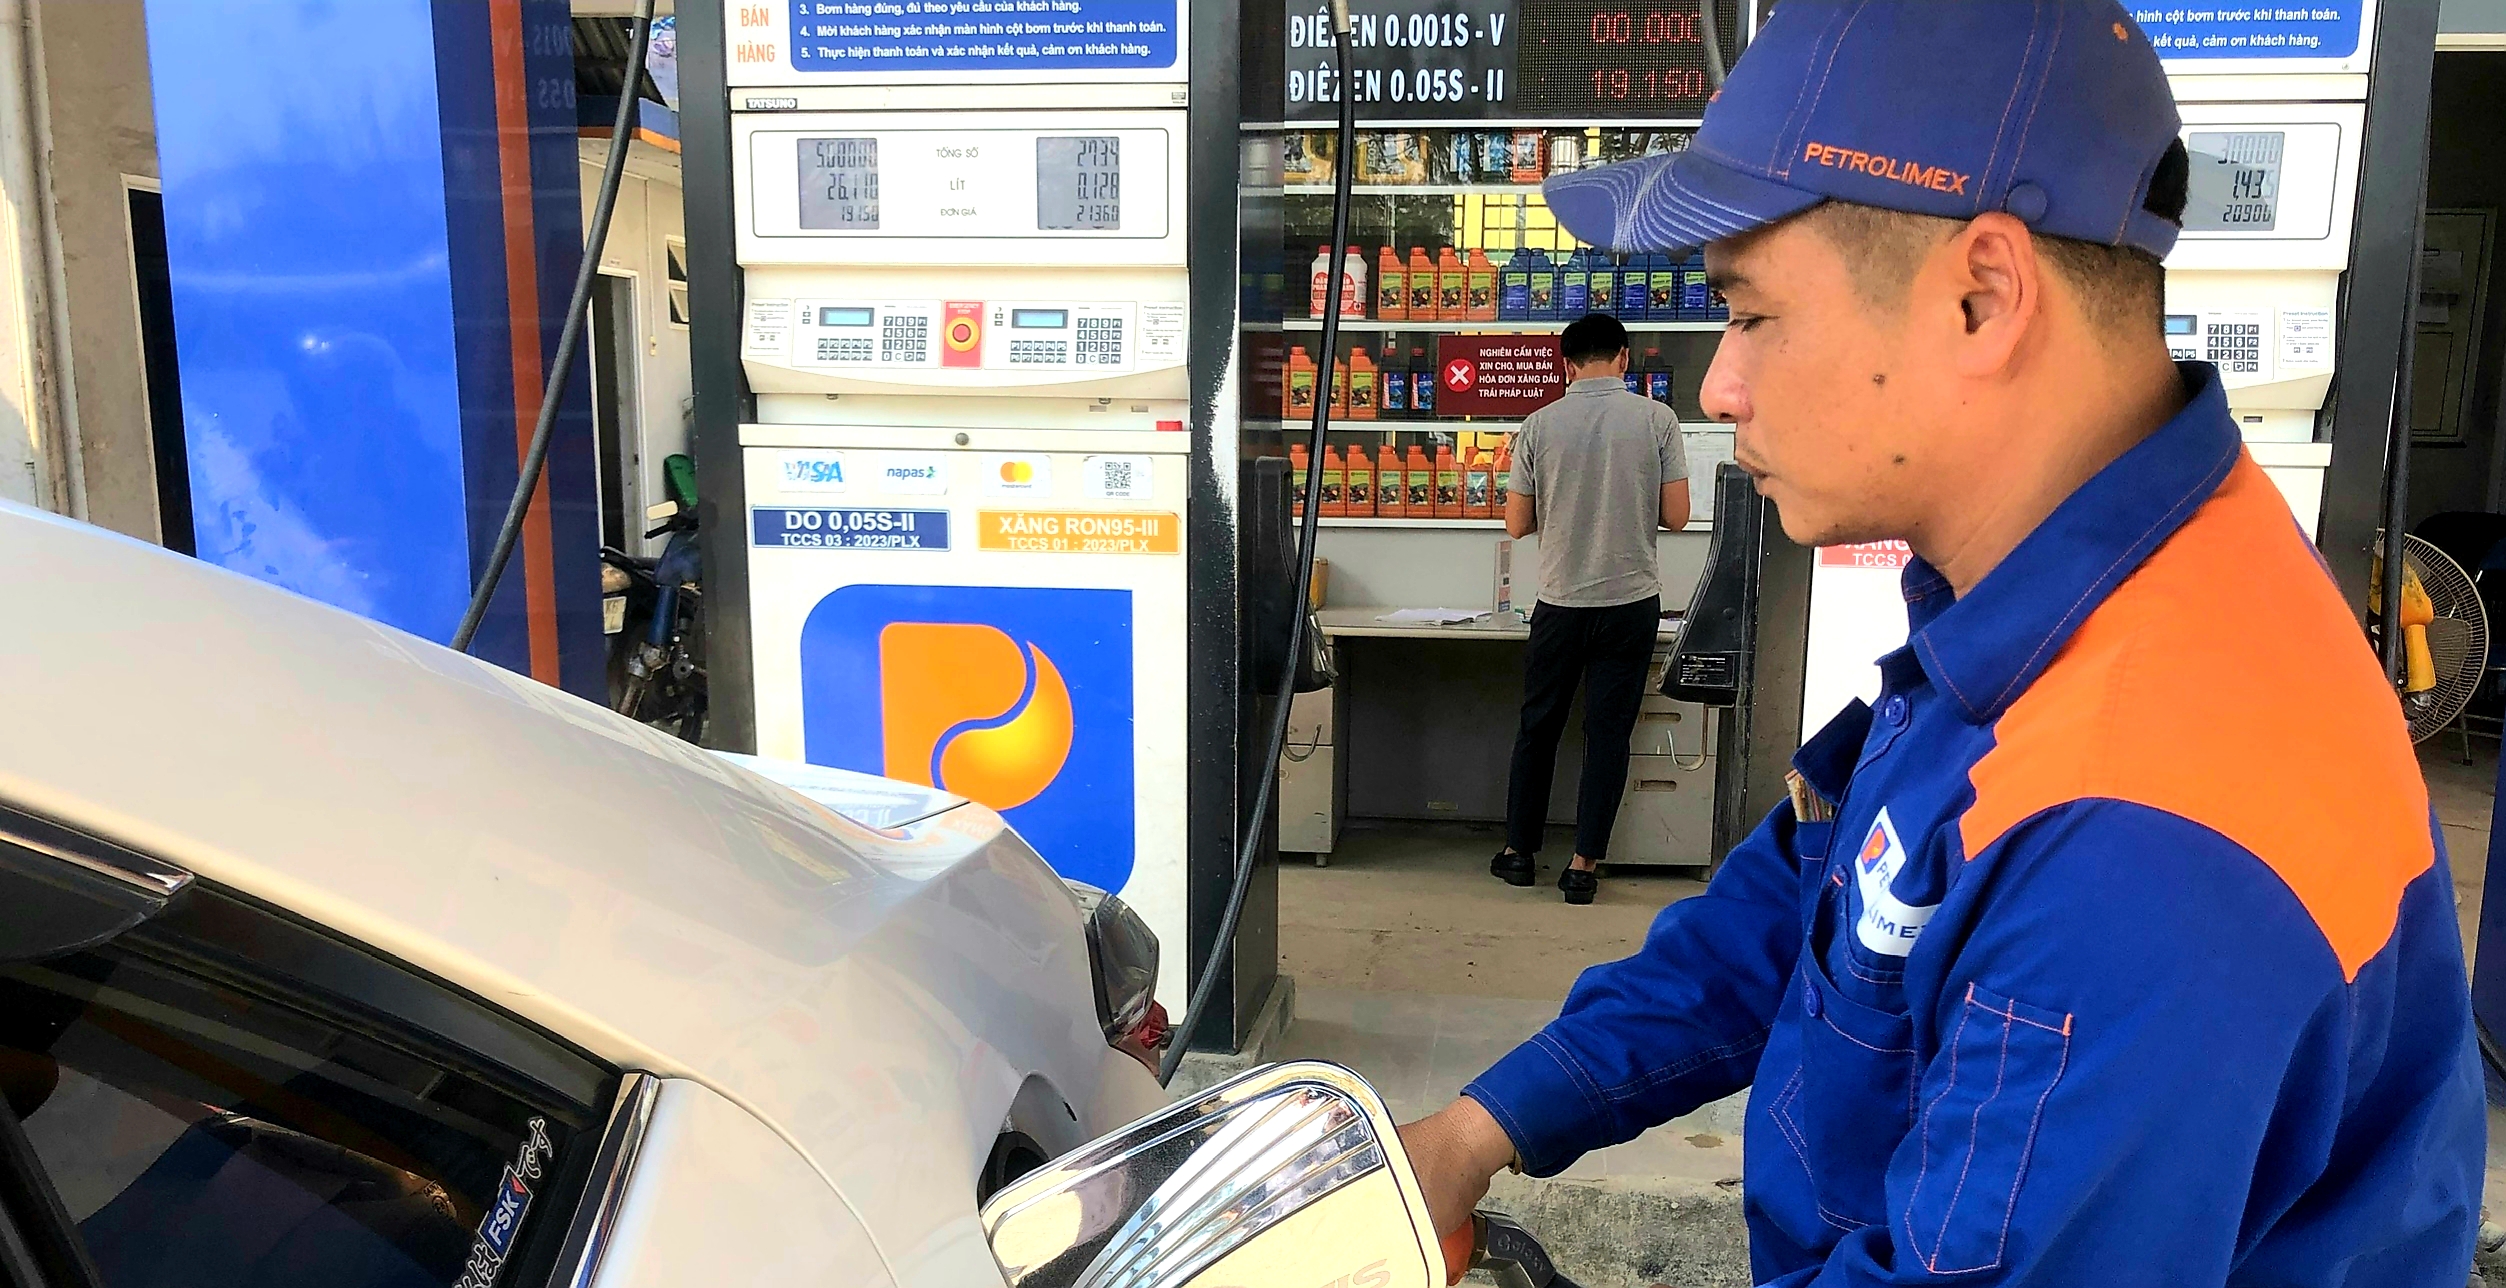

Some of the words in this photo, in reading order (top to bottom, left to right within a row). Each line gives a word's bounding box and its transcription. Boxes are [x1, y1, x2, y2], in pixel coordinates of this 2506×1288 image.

[741, 4, 769, 27] BÁN
[800, 4, 809, 15] 3.
[817, 4, 842, 14] Bơm
[845, 3, 872, 16] hàng
[874, 2, 904, 16] đúng,
[907, 2, 920, 13] đủ
[925, 2, 948, 12] theo
[950, 2, 969, 15] yêu
[995, 2, 1014, 12] của
[1017, 0, 1049, 12] khách
[1052, 0, 1082, 13] hàng.
[2136, 9, 2162, 22] hình
[2166, 9, 2185, 24] cột
[2187, 9, 2214, 22] bơm
[2217, 9, 2250, 21] trước
[2254, 8, 2272, 21] khi
[2275, 8, 2311, 21] thanh
[2312, 7, 2340, 21] toán.
[800, 26, 810, 36] 4.
[817, 25, 837, 36] Mời
[840, 25, 872, 36] khách
[875, 25, 901, 38] hàng
[903, 24, 922, 35] xác
[925, 23, 952, 37] nhận
[954, 24, 977, 35] màn
[980, 23, 1003, 34] hình
[1006, 22, 1023, 36] cột
[1026, 22, 1051, 34] bơm
[1053, 21, 1084, 34] trước
[1087, 22, 1103, 33] khi
[1106, 22, 1136, 33] thanh
[1139, 20, 1166, 33] toán.
[1290, 6, 1377, 47] ĐIÊEN
[1385, 13, 1469, 47] 0.001S
[1490, 14, 1505, 45] V
[2153, 33, 2171, 47] kết
[2174, 34, 2199, 49] quả,
[2203, 34, 2226, 47] cảm
[2230, 35, 2247, 46] ơn
[2250, 34, 2285, 46] khách
[2289, 34, 2321, 48] hàng.
[737, 40, 775, 62] HÀNG
[801, 47, 811, 58] 5.
[817, 47, 845, 60] Thực
[848, 46, 870, 59] hiện
[873, 46, 903, 58] thanh
[906, 45, 929, 57] toán
[931, 46, 944, 57] và
[947, 45, 966, 57] xác
[968, 45, 995, 58] nhận
[998, 42, 1014, 56] kết
[1016, 43, 1039, 58] quả,
[1042, 43, 1065, 55] cảm
[1068, 43, 1083, 55] ơn
[1085, 43, 1118, 55] khách
[1121, 43, 1151, 57] hàng.
[1390, 69, 1463, 101] 0.05S
[1487, 69, 1503, 101] II
[747, 98, 796, 109] TATSUNO
[936, 147, 962, 158] TỔNG
[966, 147, 979, 158] SỐ
[1804, 142, 1970, 196] PETROLIMEX
[950, 178, 965, 190] LÍT
[940, 208, 959, 216] ĐƠN
[961, 206, 977, 216] GIÁ
[1077, 205, 1119, 222] 21360
[1480, 347, 1511, 357] NGHIÊM
[1514, 345, 1531, 356] CẤM
[1534, 347, 1552, 358] VIỆC
[1480, 362, 1493, 370] XIN
[1495, 362, 1514, 370] CHO,
[1516, 362, 1533, 370] MUA
[1536, 360, 1552, 370] BÁN
[1498, 375, 1515, 383] ĐƠN
[1518, 373, 1540, 383] XĂNG
[1479, 387, 1497, 397] TRÁI
[1499, 387, 1521, 397] PHÁP
[1523, 387, 1544, 399] LUẬT
[887, 468, 924, 480] napas
[785, 511, 822, 529] DO
[829, 512, 915, 533] 0,05S-II
[1000, 512, 1058, 534] XĂNG
[1066, 517, 1159, 536] RON95-III
[781, 533, 822, 546] TCCS
[825, 534, 842, 546] 03
[854, 534, 921, 548] 2023/PLX
[1008, 537, 1048, 550] TCCS
[1053, 538, 1068, 550] 01
[1083, 538, 1148, 552] 2023/PLX
[1852, 554, 1897, 566] TCCS
[488, 1190, 520, 1246] FSK
